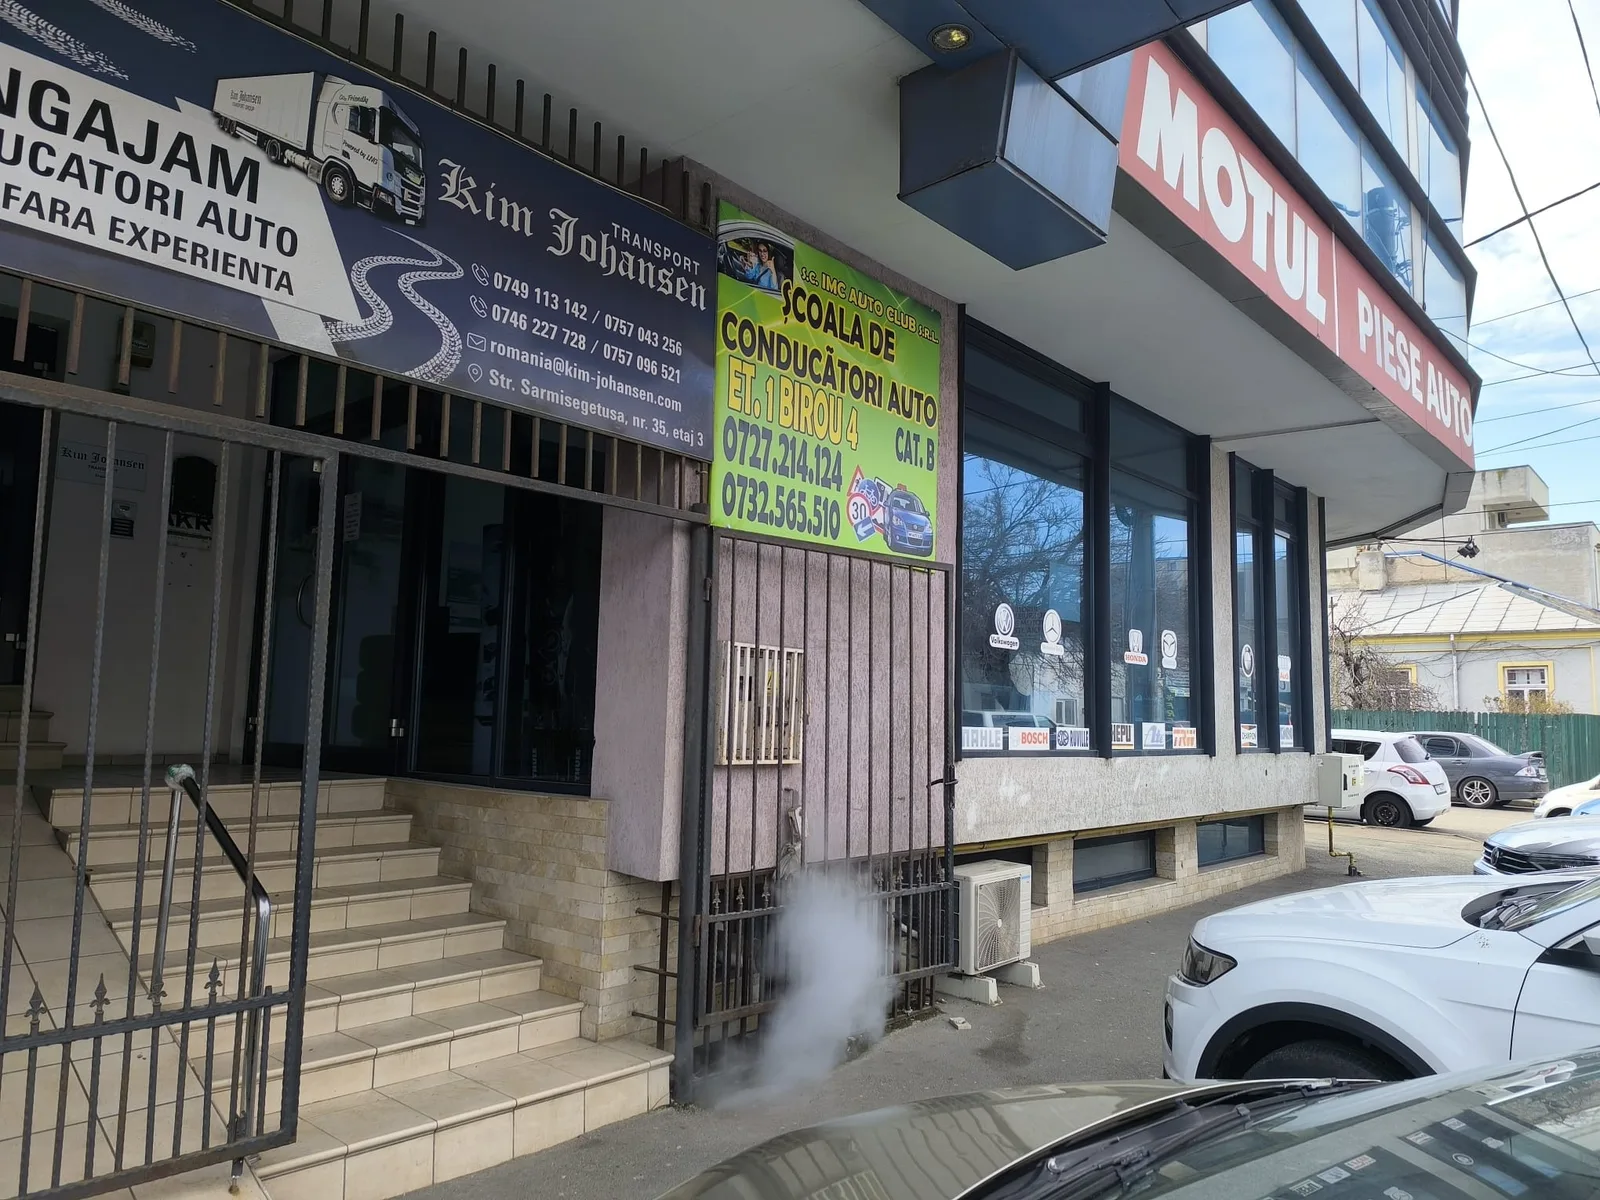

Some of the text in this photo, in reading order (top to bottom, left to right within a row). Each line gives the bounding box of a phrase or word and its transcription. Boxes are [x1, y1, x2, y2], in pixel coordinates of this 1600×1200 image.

[1136, 55, 1327, 325] MOTUL
[2, 183, 294, 296] FARA EXPERIENTA
[196, 200, 298, 257] AUTO
[438, 158, 707, 311] Kim Johansen
[612, 223, 700, 276] TRANSPORT
[494, 272, 682, 356] 0749 113 142 / 0757 043 256
[821, 272, 846, 299] IMC
[849, 287, 884, 317] AUTO
[886, 306, 917, 333] CLUB
[492, 304, 681, 384] 0746 227 728 / 0757 096 521
[869, 322, 896, 363] DE
[1357, 287, 1473, 448] PIESE AUTO
[489, 368, 704, 447] Str. Sarmisegetusa, nr. 35, etaj 3
[490, 340, 682, 412] romania@kim-johansen.com
[728, 355, 858, 451] ET. 1 BIROU 4
[888, 381, 938, 428] AUTO
[90, 451, 144, 470] Joansen
[723, 415, 843, 492] 0727.214.124
[895, 427, 935, 472] CAT. B
[722, 472, 840, 540] 0732.565.510
[852, 501, 867, 521] 30
[990, 636, 1018, 648] Volkswagen
[1125, 654, 1147, 664] HONDA
[1021, 732, 1048, 746] BOSCH
